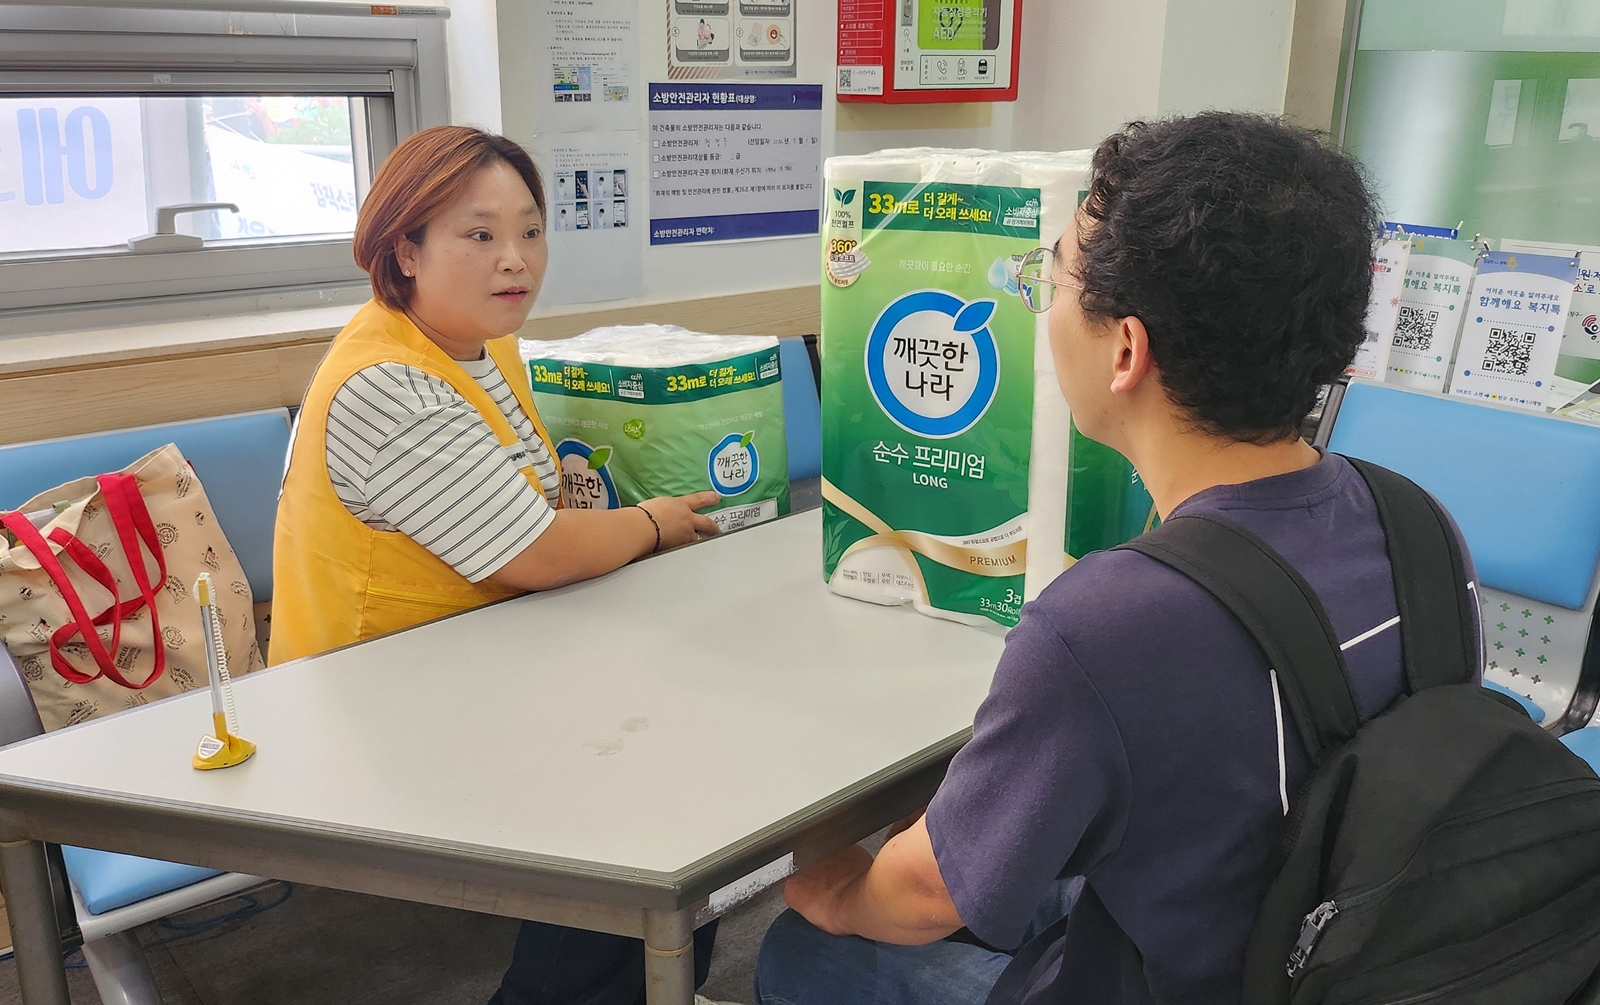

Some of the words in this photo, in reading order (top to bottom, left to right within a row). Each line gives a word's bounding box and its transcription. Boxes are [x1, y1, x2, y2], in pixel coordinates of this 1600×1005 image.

[933, 28, 954, 40] AED
[653, 92, 710, 104] 소방안전관리자
[748, 138, 771, 146] (선임일자:
[661, 154, 708, 162] 소방안전관리대상물
[710, 153, 722, 161] 등급:
[661, 170, 698, 178] 소방안전관리자
[868, 194, 920, 214] 33m로
[924, 192, 934, 205] 더
[924, 207, 933, 220] 더
[936, 207, 956, 220] 오래
[958, 209, 992, 222] 쓰세요!
[1005, 207, 1038, 219] 소비자중심
[832, 220, 854, 228] 천연펄프
[654, 228, 695, 238] 소방안전관리자
[696, 226, 715, 236] 연락처:
[930, 262, 953, 272] 필요한
[956, 263, 971, 274] 순간
[1434, 273, 1460, 282] 알려주세요
[1403, 278, 1428, 290] 께해요
[1486, 287, 1504, 296] 어려운
[1506, 289, 1525, 298] 이웃을
[1528, 292, 1559, 301] 알려주세요
[1480, 296, 1522, 310] 함께해요
[1528, 302, 1561, 315] 복지톡
[894, 338, 968, 372] 깨끗한
[533, 365, 563, 385] 33m로
[564, 366, 571, 378] 더
[709, 369, 718, 377] 더
[564, 379, 571, 390] 더
[572, 380, 585, 392] 오래
[586, 381, 611, 393] 쓰세요!
[618, 380, 644, 390] 소비자중심
[666, 375, 707, 392] 33m로
[710, 379, 717, 388] 더
[718, 376, 732, 386] 오래
[734, 372, 756, 384] 쓰세요!
[905, 371, 954, 401] 나라
[717, 452, 748, 468] 깨끗한
[872, 440, 909, 465] 순수
[913, 446, 986, 480] 프리미엄
[723, 468, 746, 481] 나라
[562, 472, 602, 498] 깨끗한
[913, 473, 948, 489] LONG
[730, 506, 761, 523] 프리미엄
[728, 521, 745, 530] LONG
[970, 555, 1017, 566] PREMIUM
[75, 699, 91, 708] TAXI
